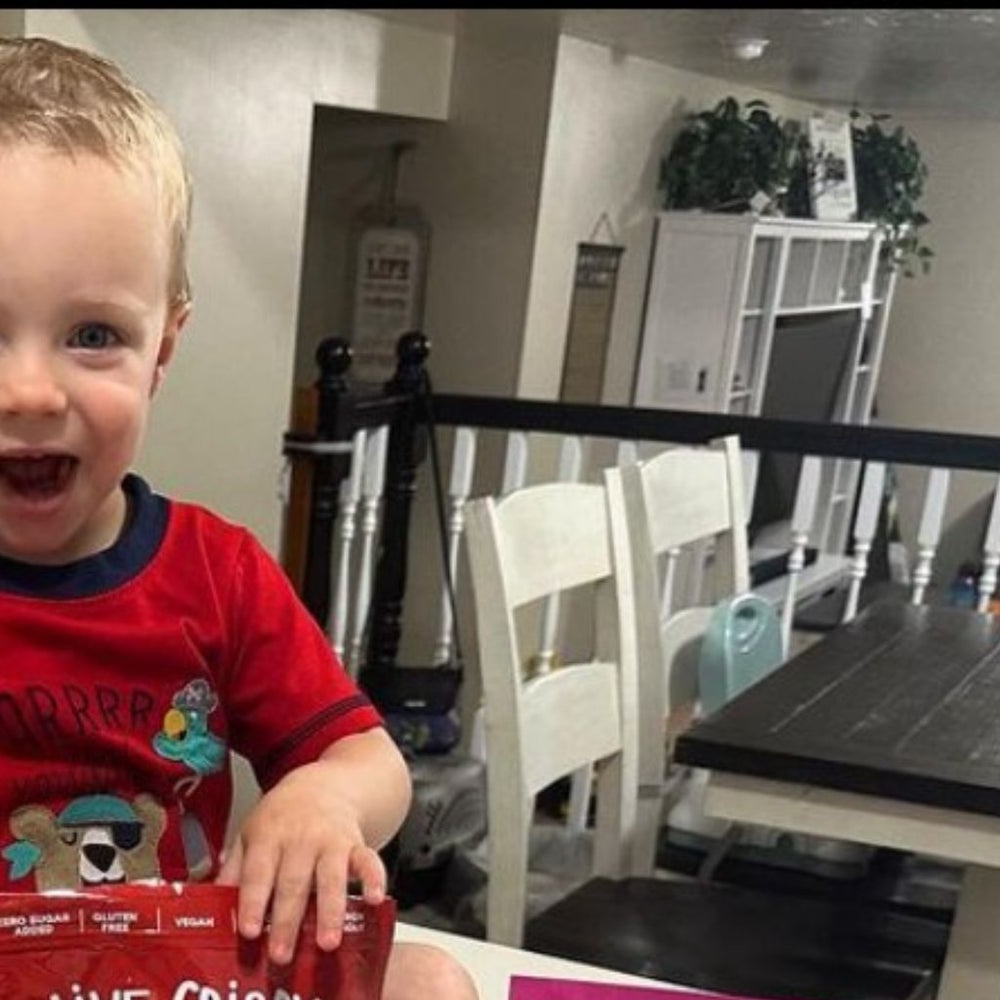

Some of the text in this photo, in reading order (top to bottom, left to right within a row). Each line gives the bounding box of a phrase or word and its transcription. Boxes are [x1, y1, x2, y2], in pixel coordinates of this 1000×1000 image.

[91, 911, 138, 923] GLUTEN
[174, 916, 215, 929] VEGAN
[100, 923, 130, 933] FREE
